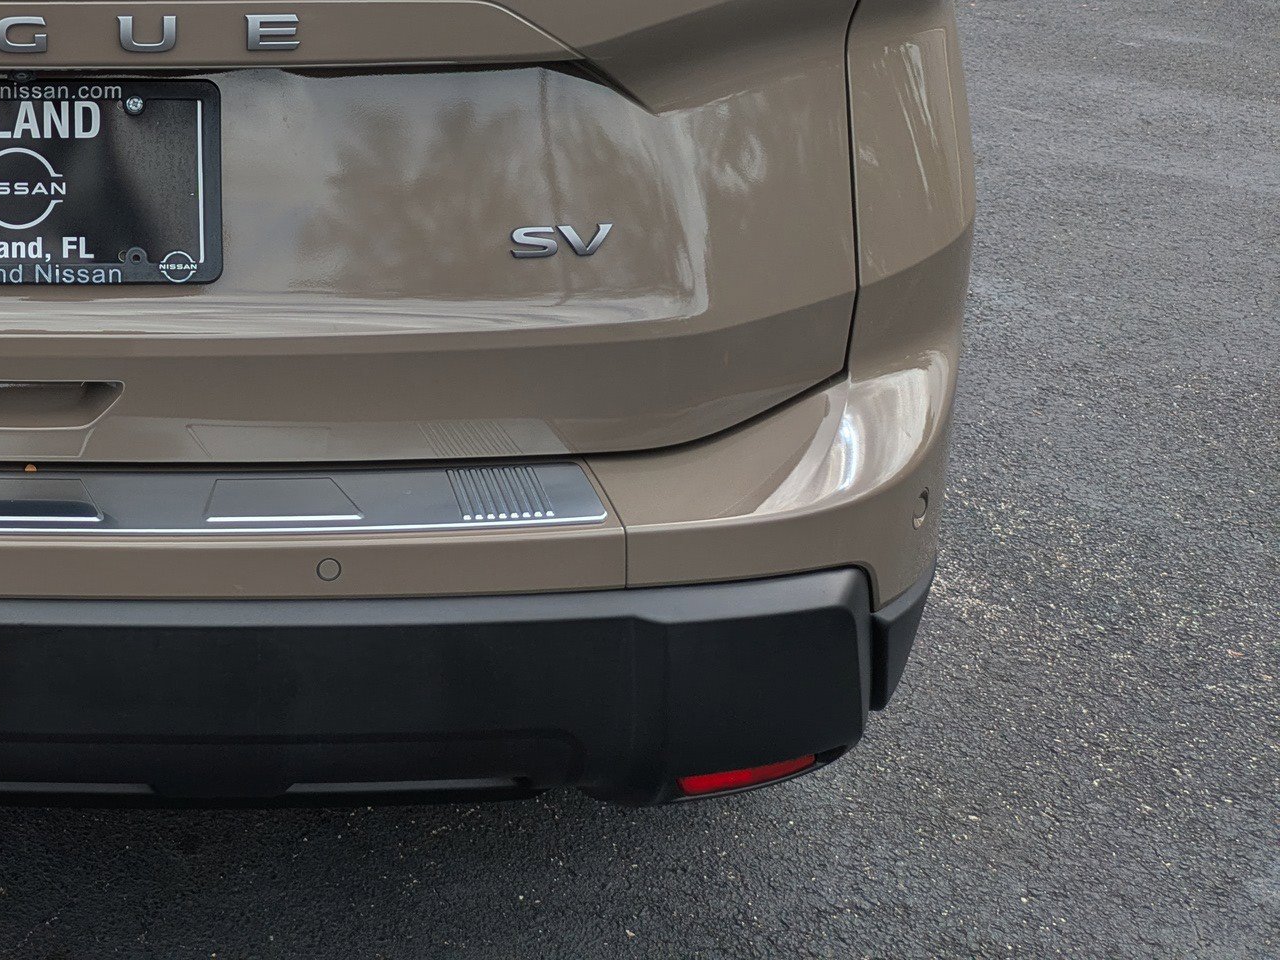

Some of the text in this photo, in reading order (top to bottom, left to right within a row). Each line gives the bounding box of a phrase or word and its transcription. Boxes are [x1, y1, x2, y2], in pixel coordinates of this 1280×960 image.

[62, 236, 95, 258] FL
[510, 224, 613, 258] SV
[35, 263, 122, 283] Nissan
[159, 261, 198, 270] NISSAN
